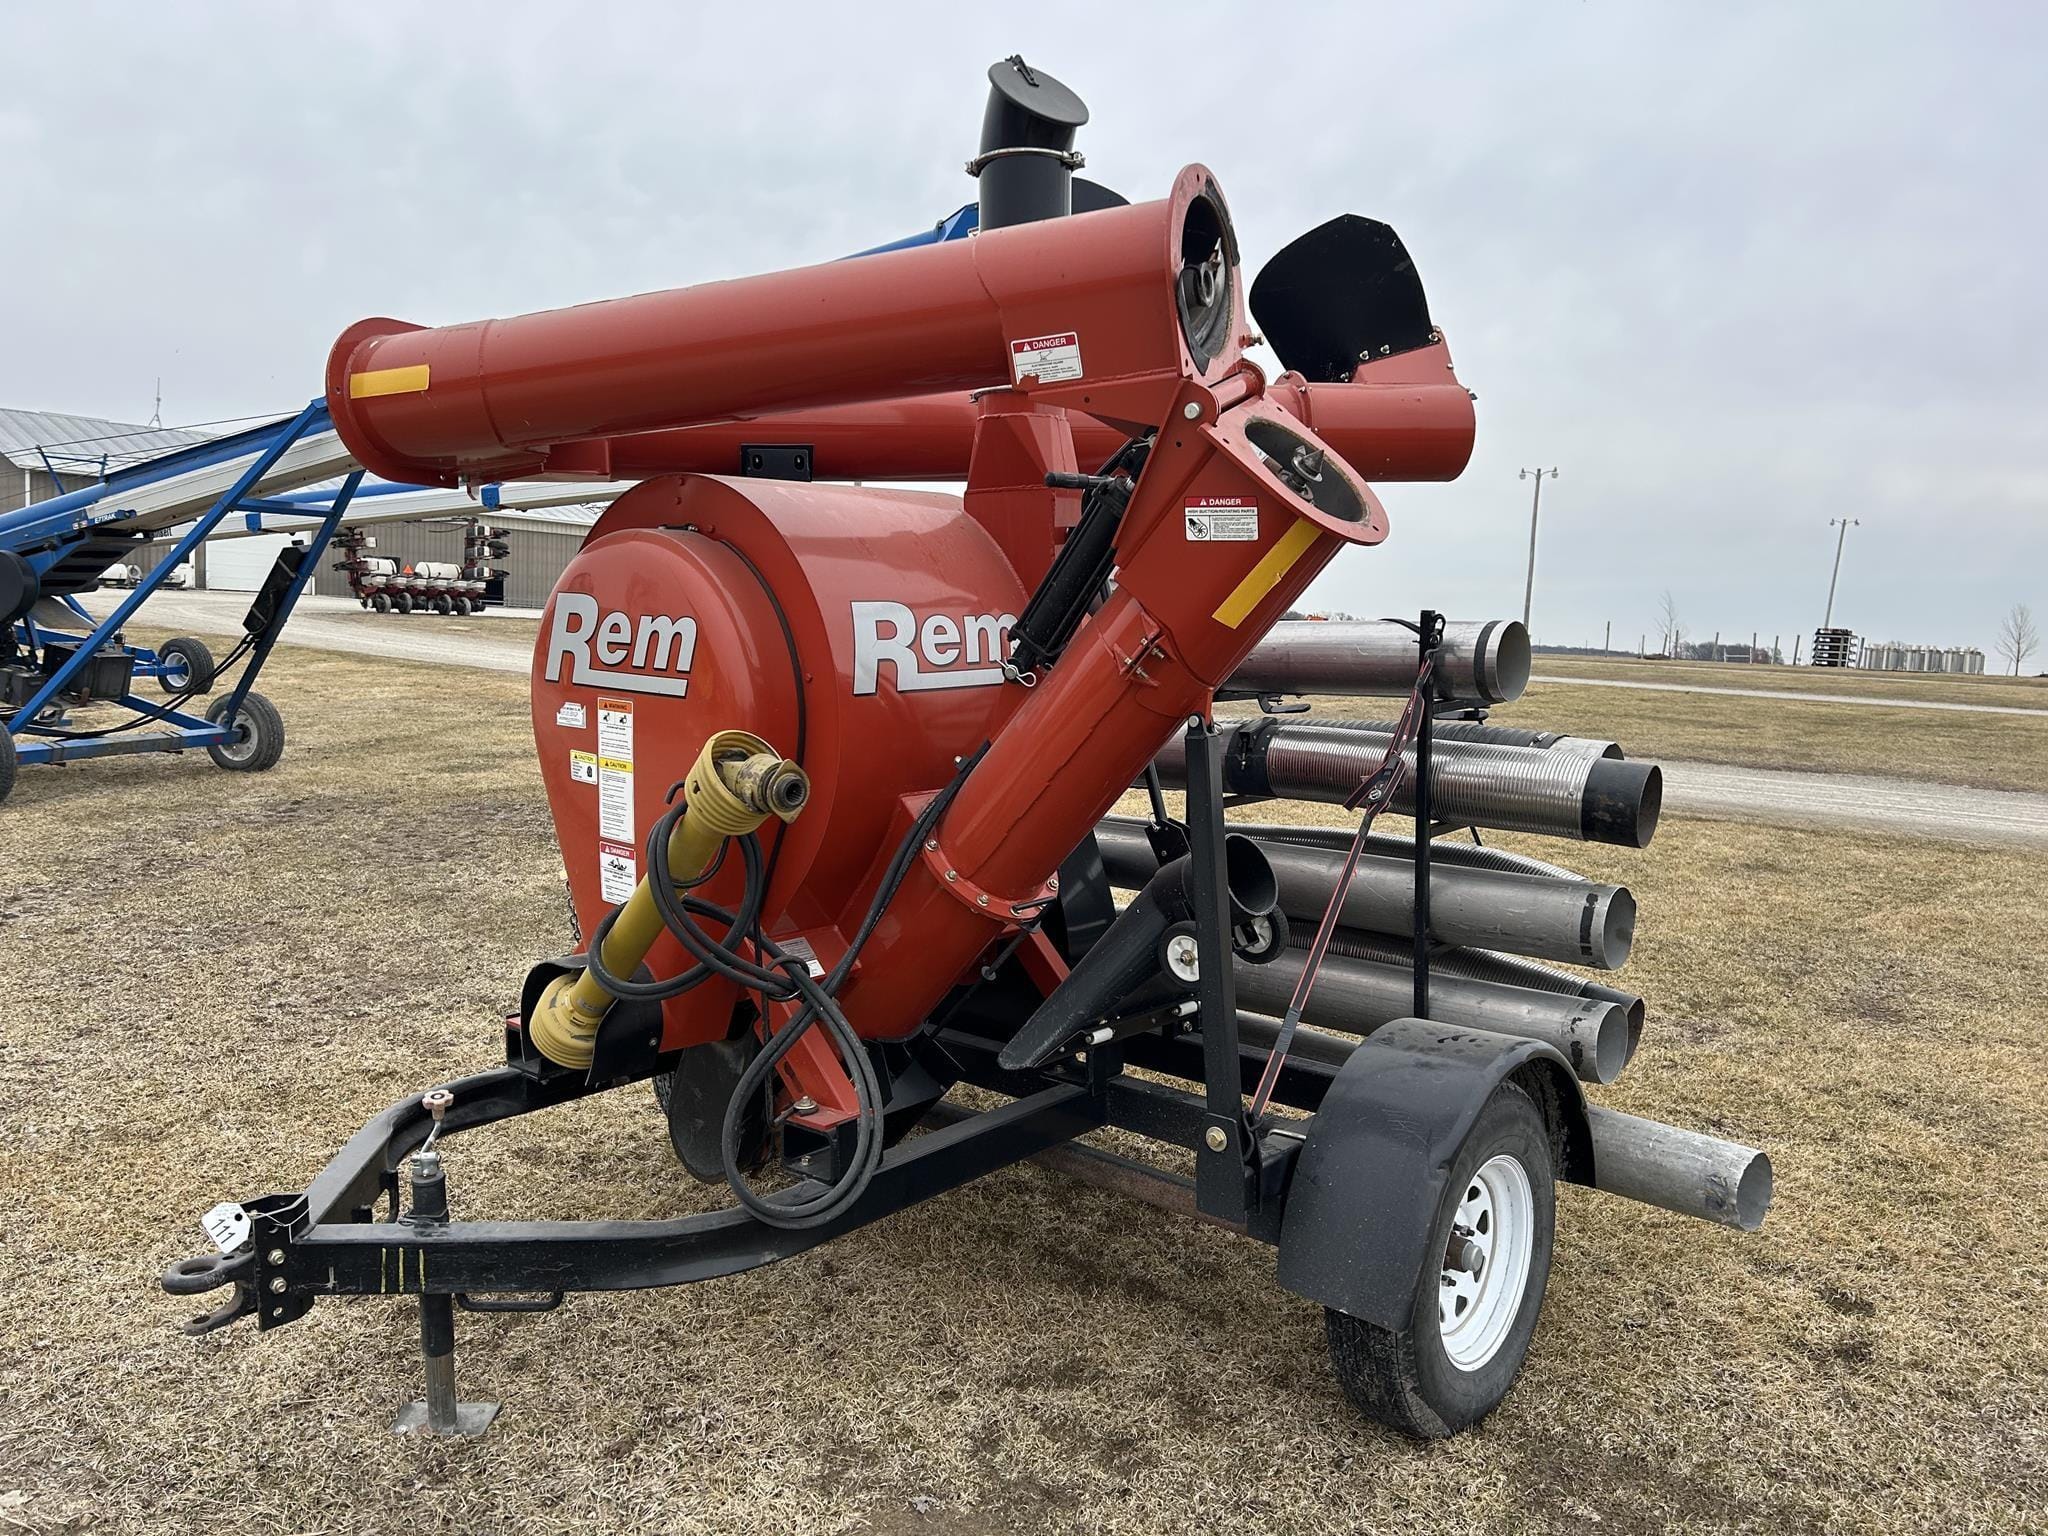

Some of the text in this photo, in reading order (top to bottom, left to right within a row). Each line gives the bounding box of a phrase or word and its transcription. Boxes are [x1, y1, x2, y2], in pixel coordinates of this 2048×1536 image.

[1032, 337, 1067, 350] DANGER
[1209, 498, 1242, 506] DANGER
[544, 592, 698, 698] Rem
[609, 703, 628, 711] WARNING
[578, 754, 594, 762] CAUTION
[609, 761, 627, 769] CAUTION
[609, 847, 630, 857] DANGER
[210, 1218, 236, 1245] 111
